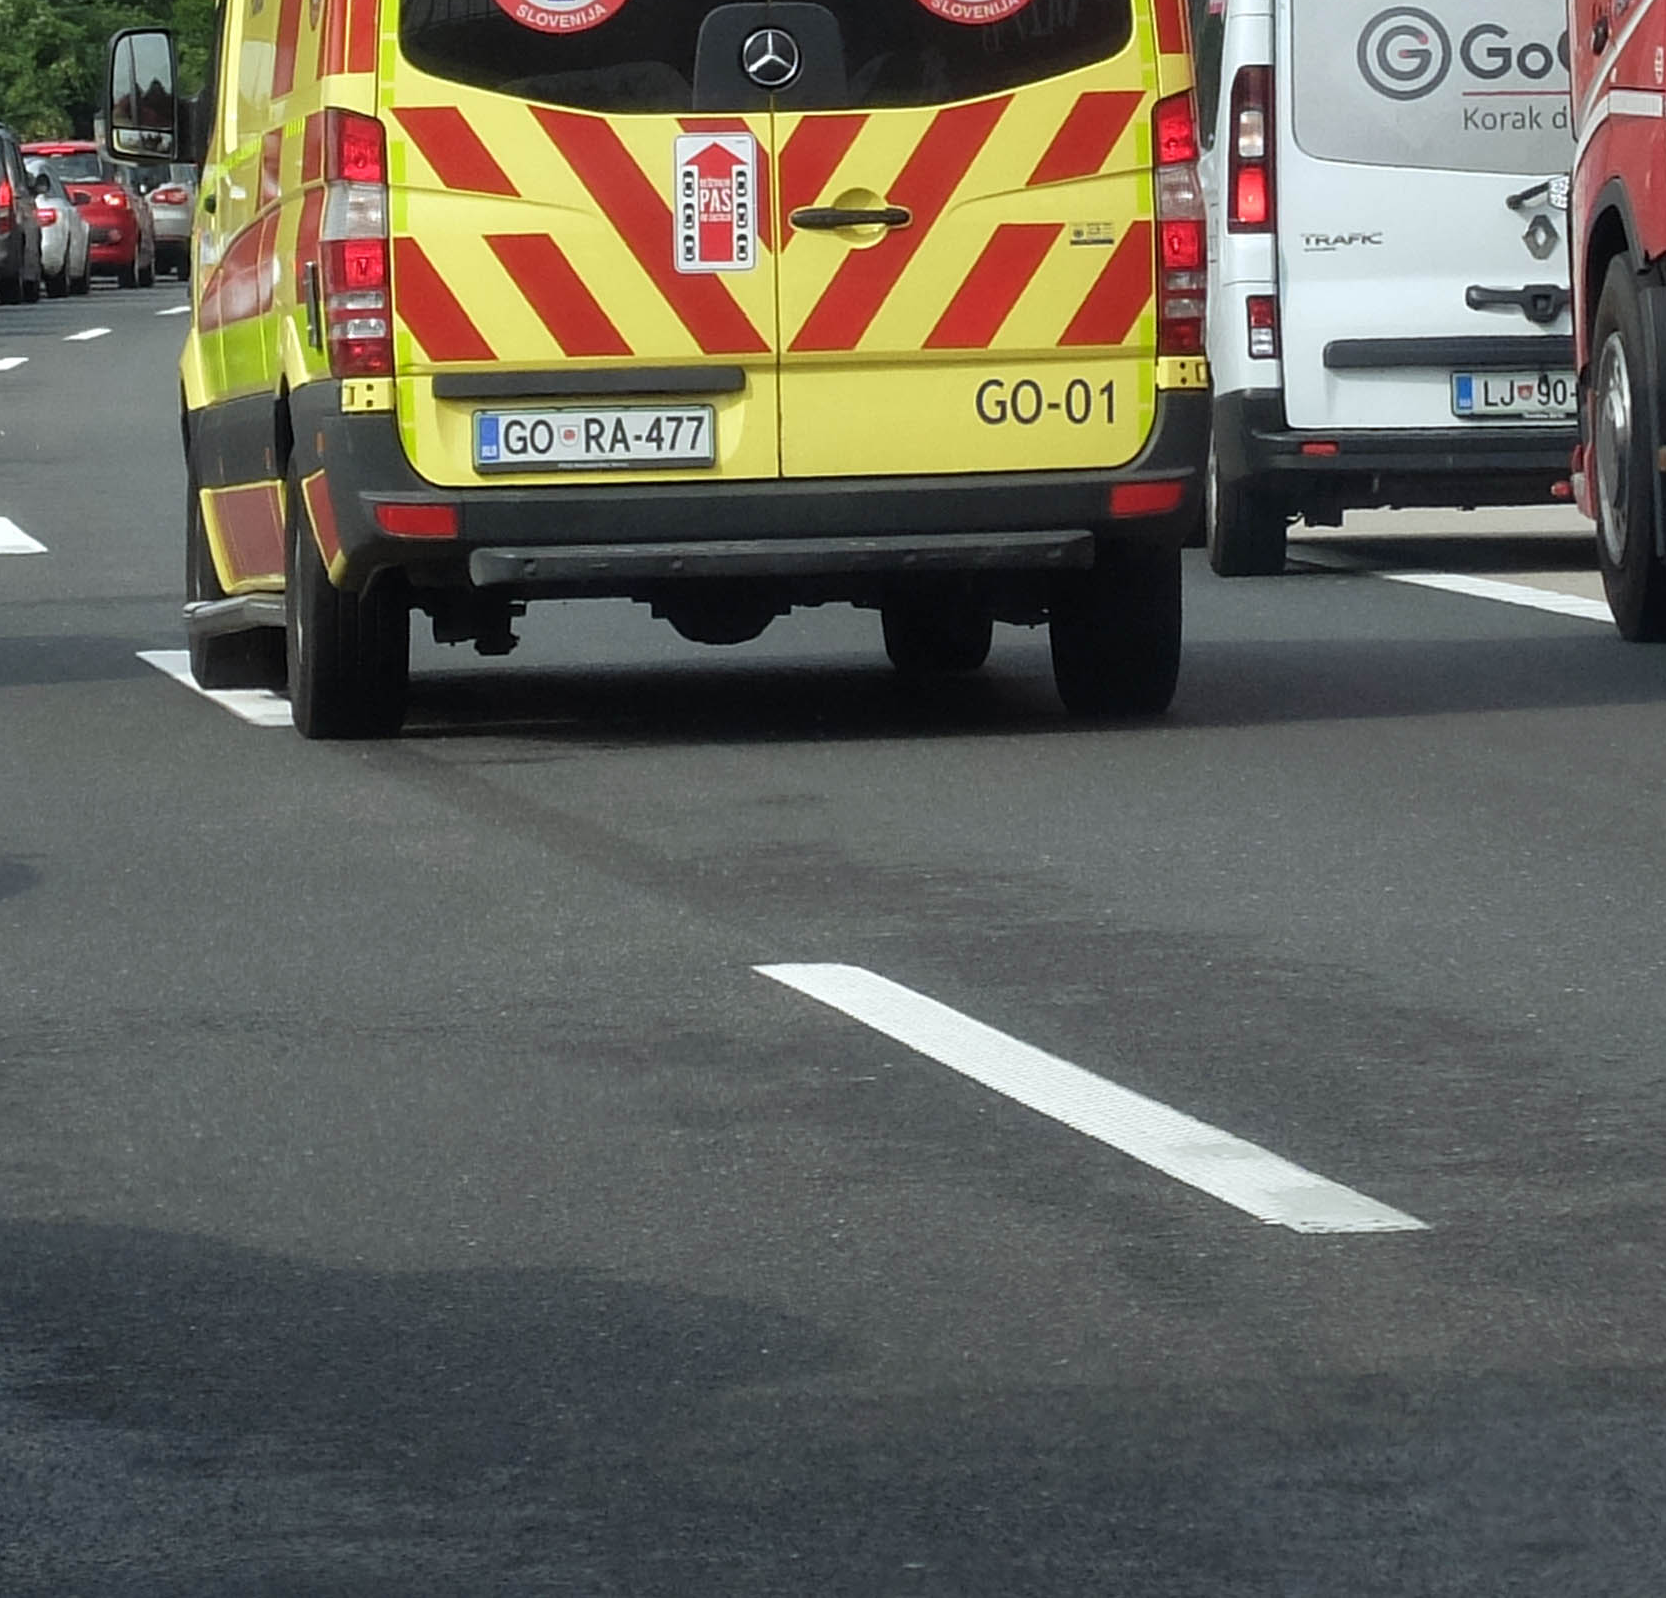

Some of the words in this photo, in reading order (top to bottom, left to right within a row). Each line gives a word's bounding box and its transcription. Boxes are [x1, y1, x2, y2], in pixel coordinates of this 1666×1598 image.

[516, 3, 608, 28] SLOVENIJA
[1459, 23, 1571, 80] Go
[1463, 105, 1542, 131] Korak
[699, 188, 732, 213] PAS
[1300, 231, 1383, 246] TRAFIC
[975, 378, 1115, 426] GO-01
[1484, 380, 1514, 406] LJ
[504, 419, 555, 455] GO
[583, 415, 705, 454] RA-477
